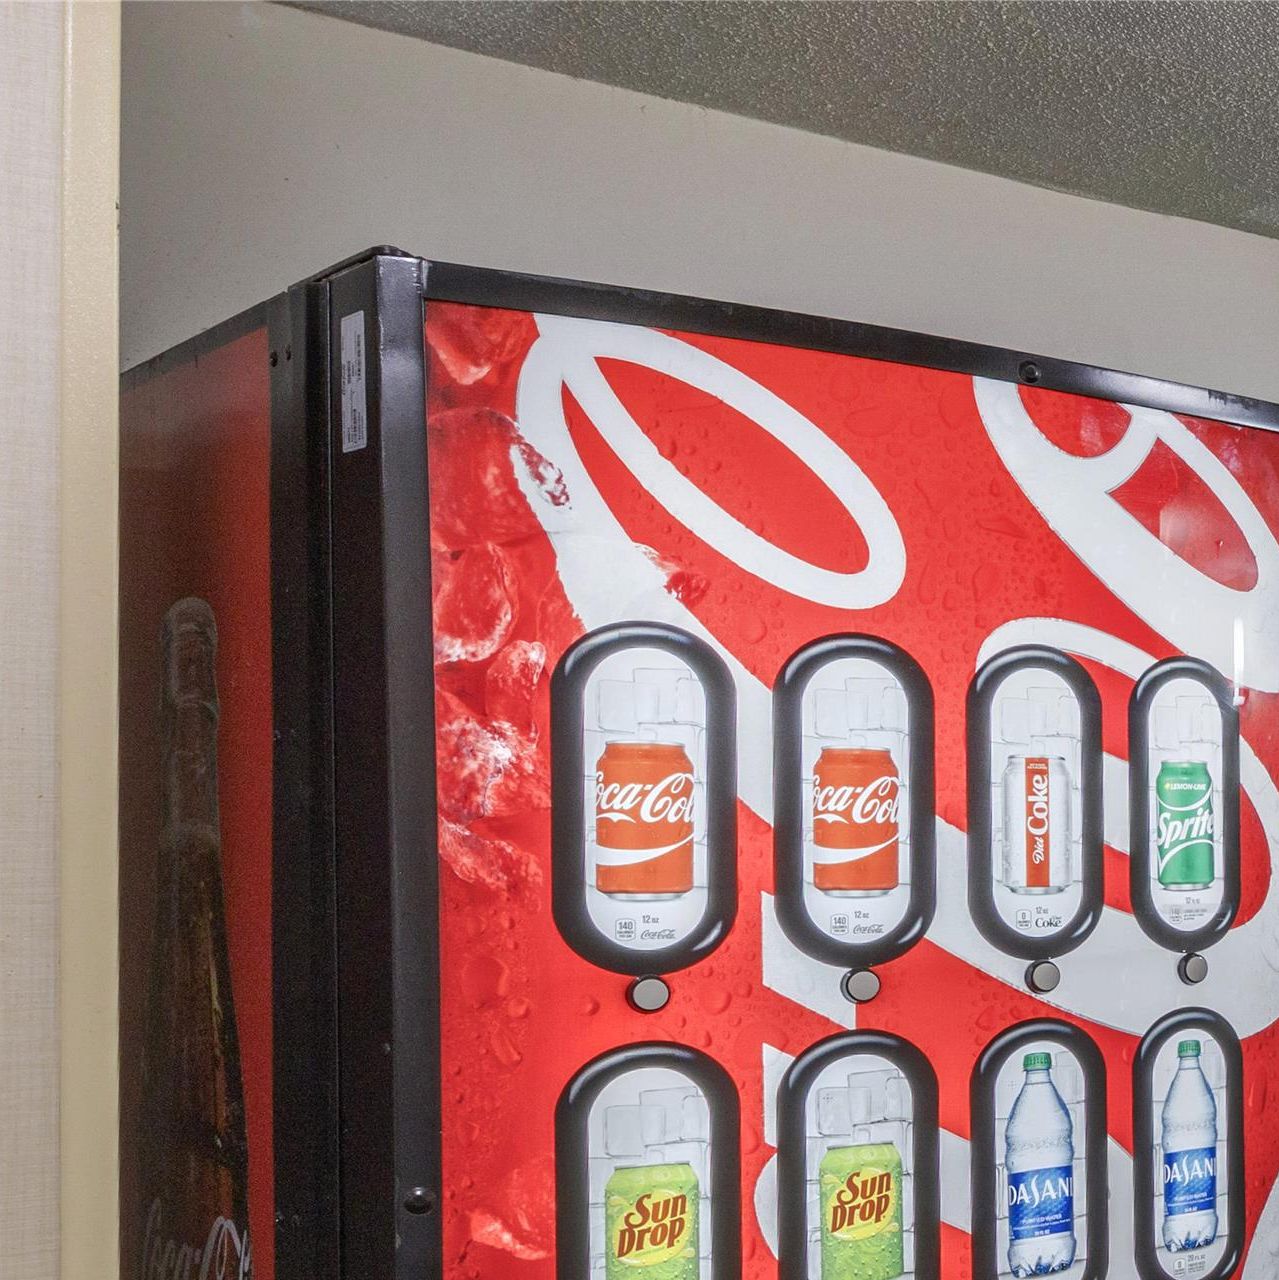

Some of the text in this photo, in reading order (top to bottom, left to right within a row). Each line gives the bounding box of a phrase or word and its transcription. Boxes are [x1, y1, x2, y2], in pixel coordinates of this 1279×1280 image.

[595, 771, 695, 824] oca-Col
[813, 775, 899, 825] oca-Col
[1027, 774, 1048, 836] Coke
[1032, 837, 1044, 864] Diet
[618, 921, 633, 930] 140
[641, 914, 651, 924] 12
[833, 916, 847, 925] 140
[853, 910, 862, 919] 12
[1164, 1154, 1216, 1186] DASANI
[836, 1170, 891, 1206] Sun
[1008, 1174, 1073, 1209] DASANI
[624, 1191, 687, 1231] Sun
[830, 1193, 890, 1233] Drop
[617, 1216, 686, 1259] Drop
